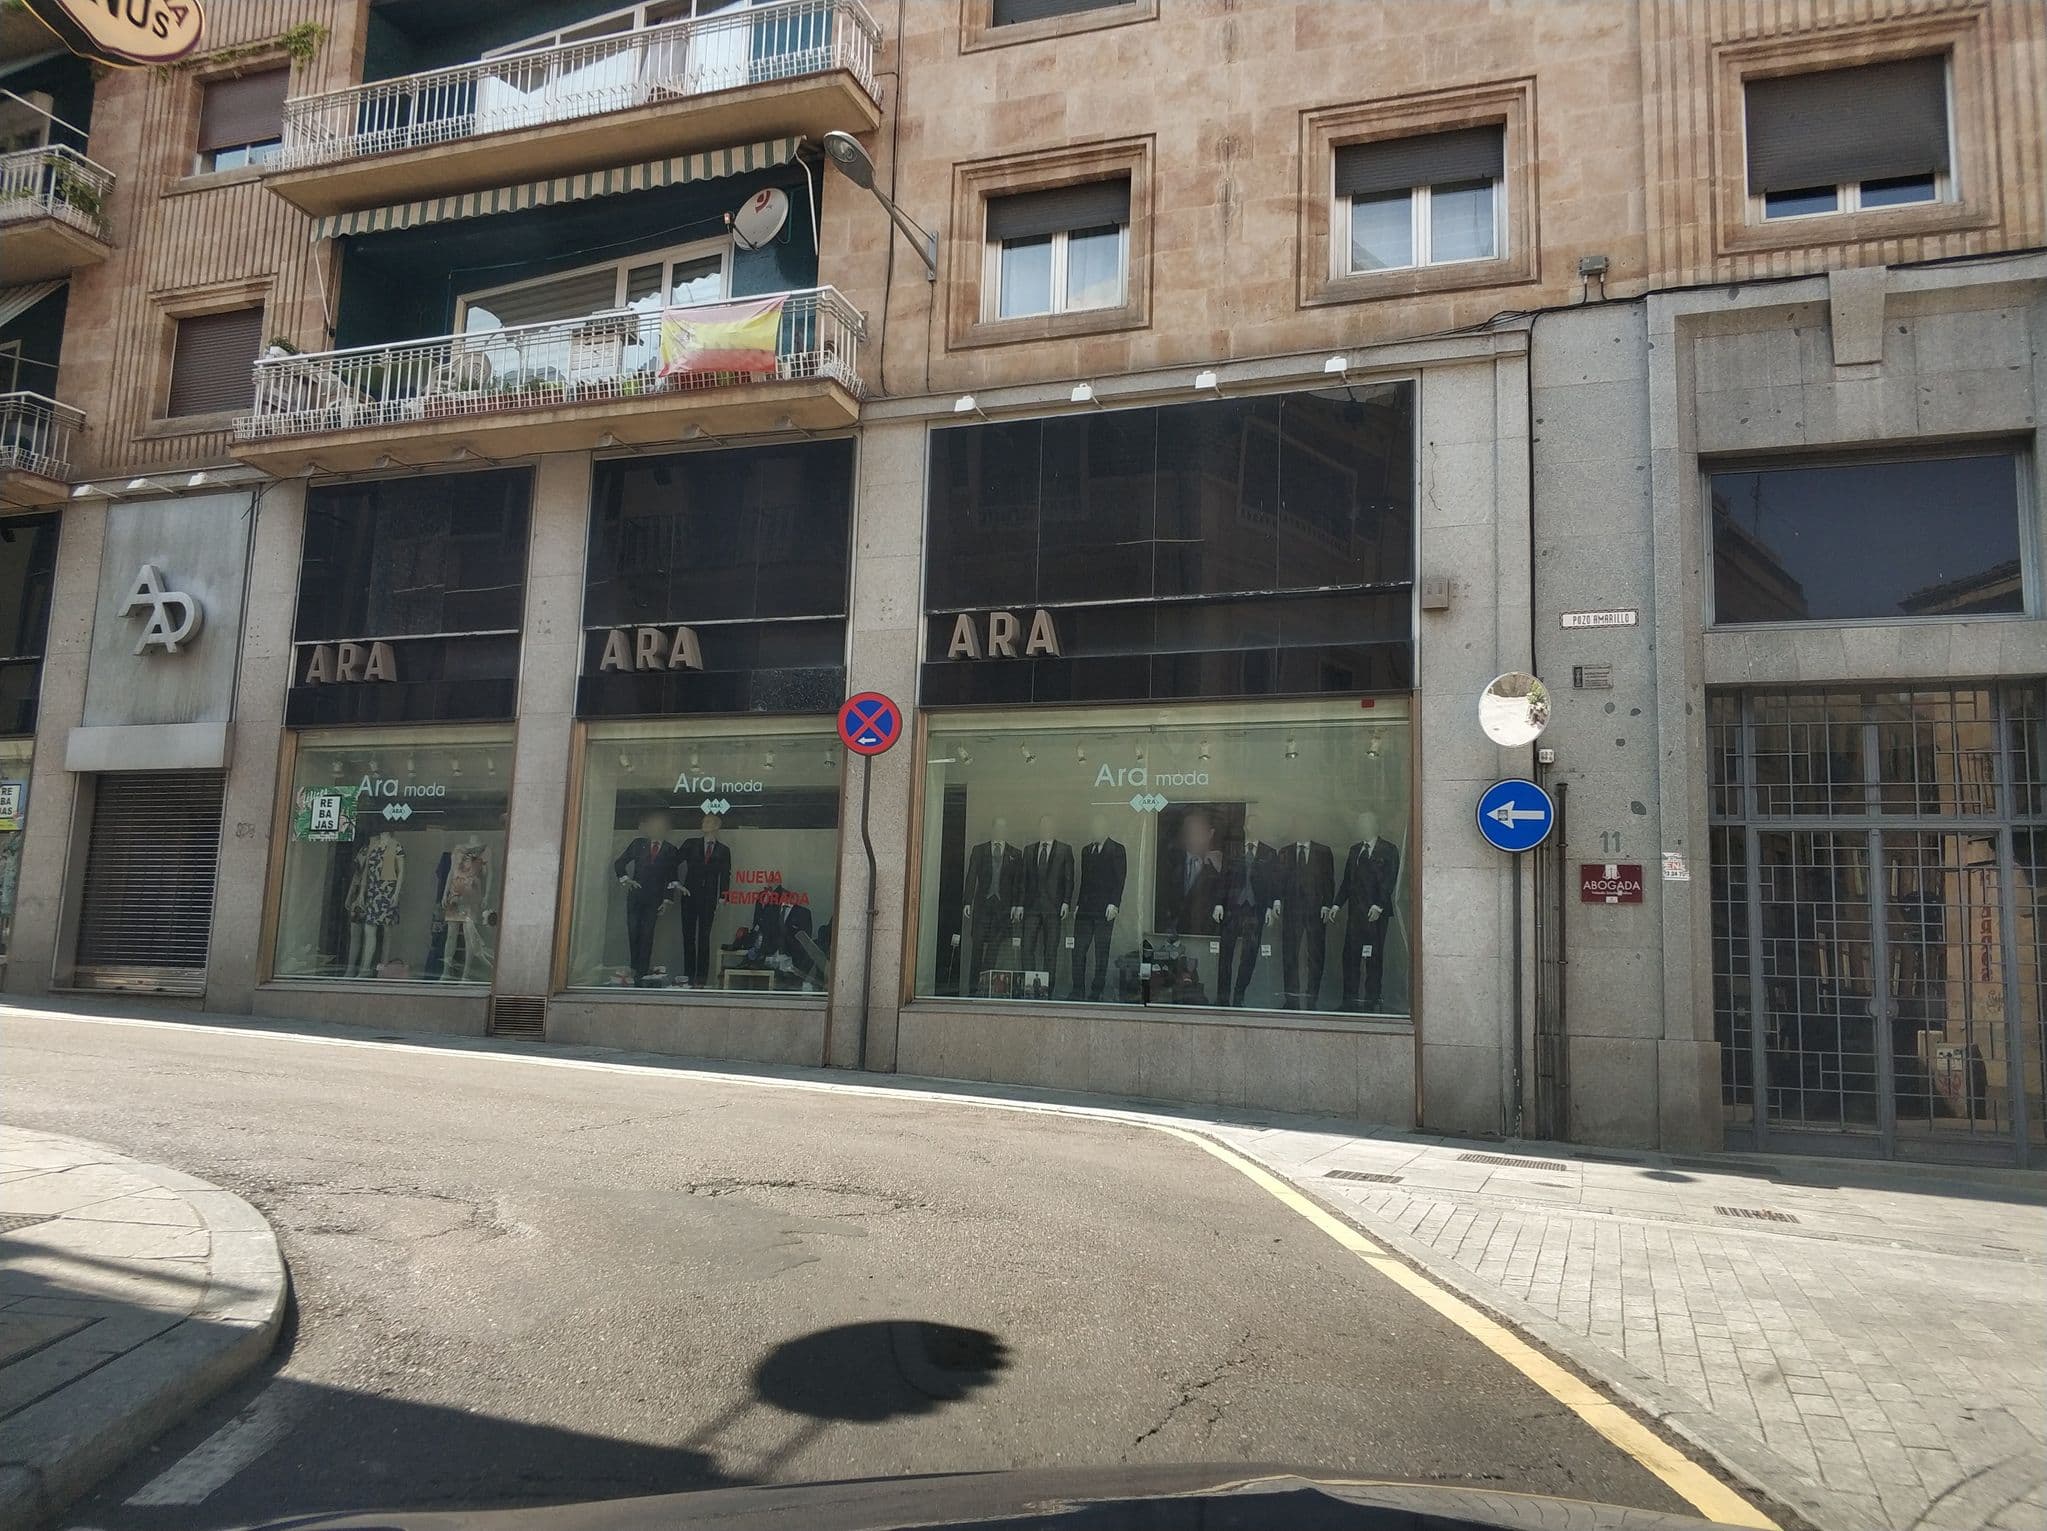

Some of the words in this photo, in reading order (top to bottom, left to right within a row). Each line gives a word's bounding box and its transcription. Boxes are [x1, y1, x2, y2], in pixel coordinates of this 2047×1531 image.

[1572, 615, 1591, 625] POZO
[1593, 613, 1630, 625] AMARILLO
[947, 609, 1060, 660] ARA
[600, 626, 703, 672] ARA
[305, 641, 397, 684] ARA
[673, 772, 716, 794] Ara
[721, 779, 763, 793] moda
[1094, 763, 1148, 787] Ara
[1155, 770, 1209, 786] moda
[1, 787, 13, 796] RE
[357, 774, 399, 797] Ara
[403, 782, 446, 797] moda
[319, 798, 333, 808] RE
[318, 809, 332, 819] BA
[315, 820, 334, 829] JAS
[1600, 830, 1621, 853] 11
[735, 870, 783, 884] NUEVA
[1583, 880, 1641, 891] ABOGADA
